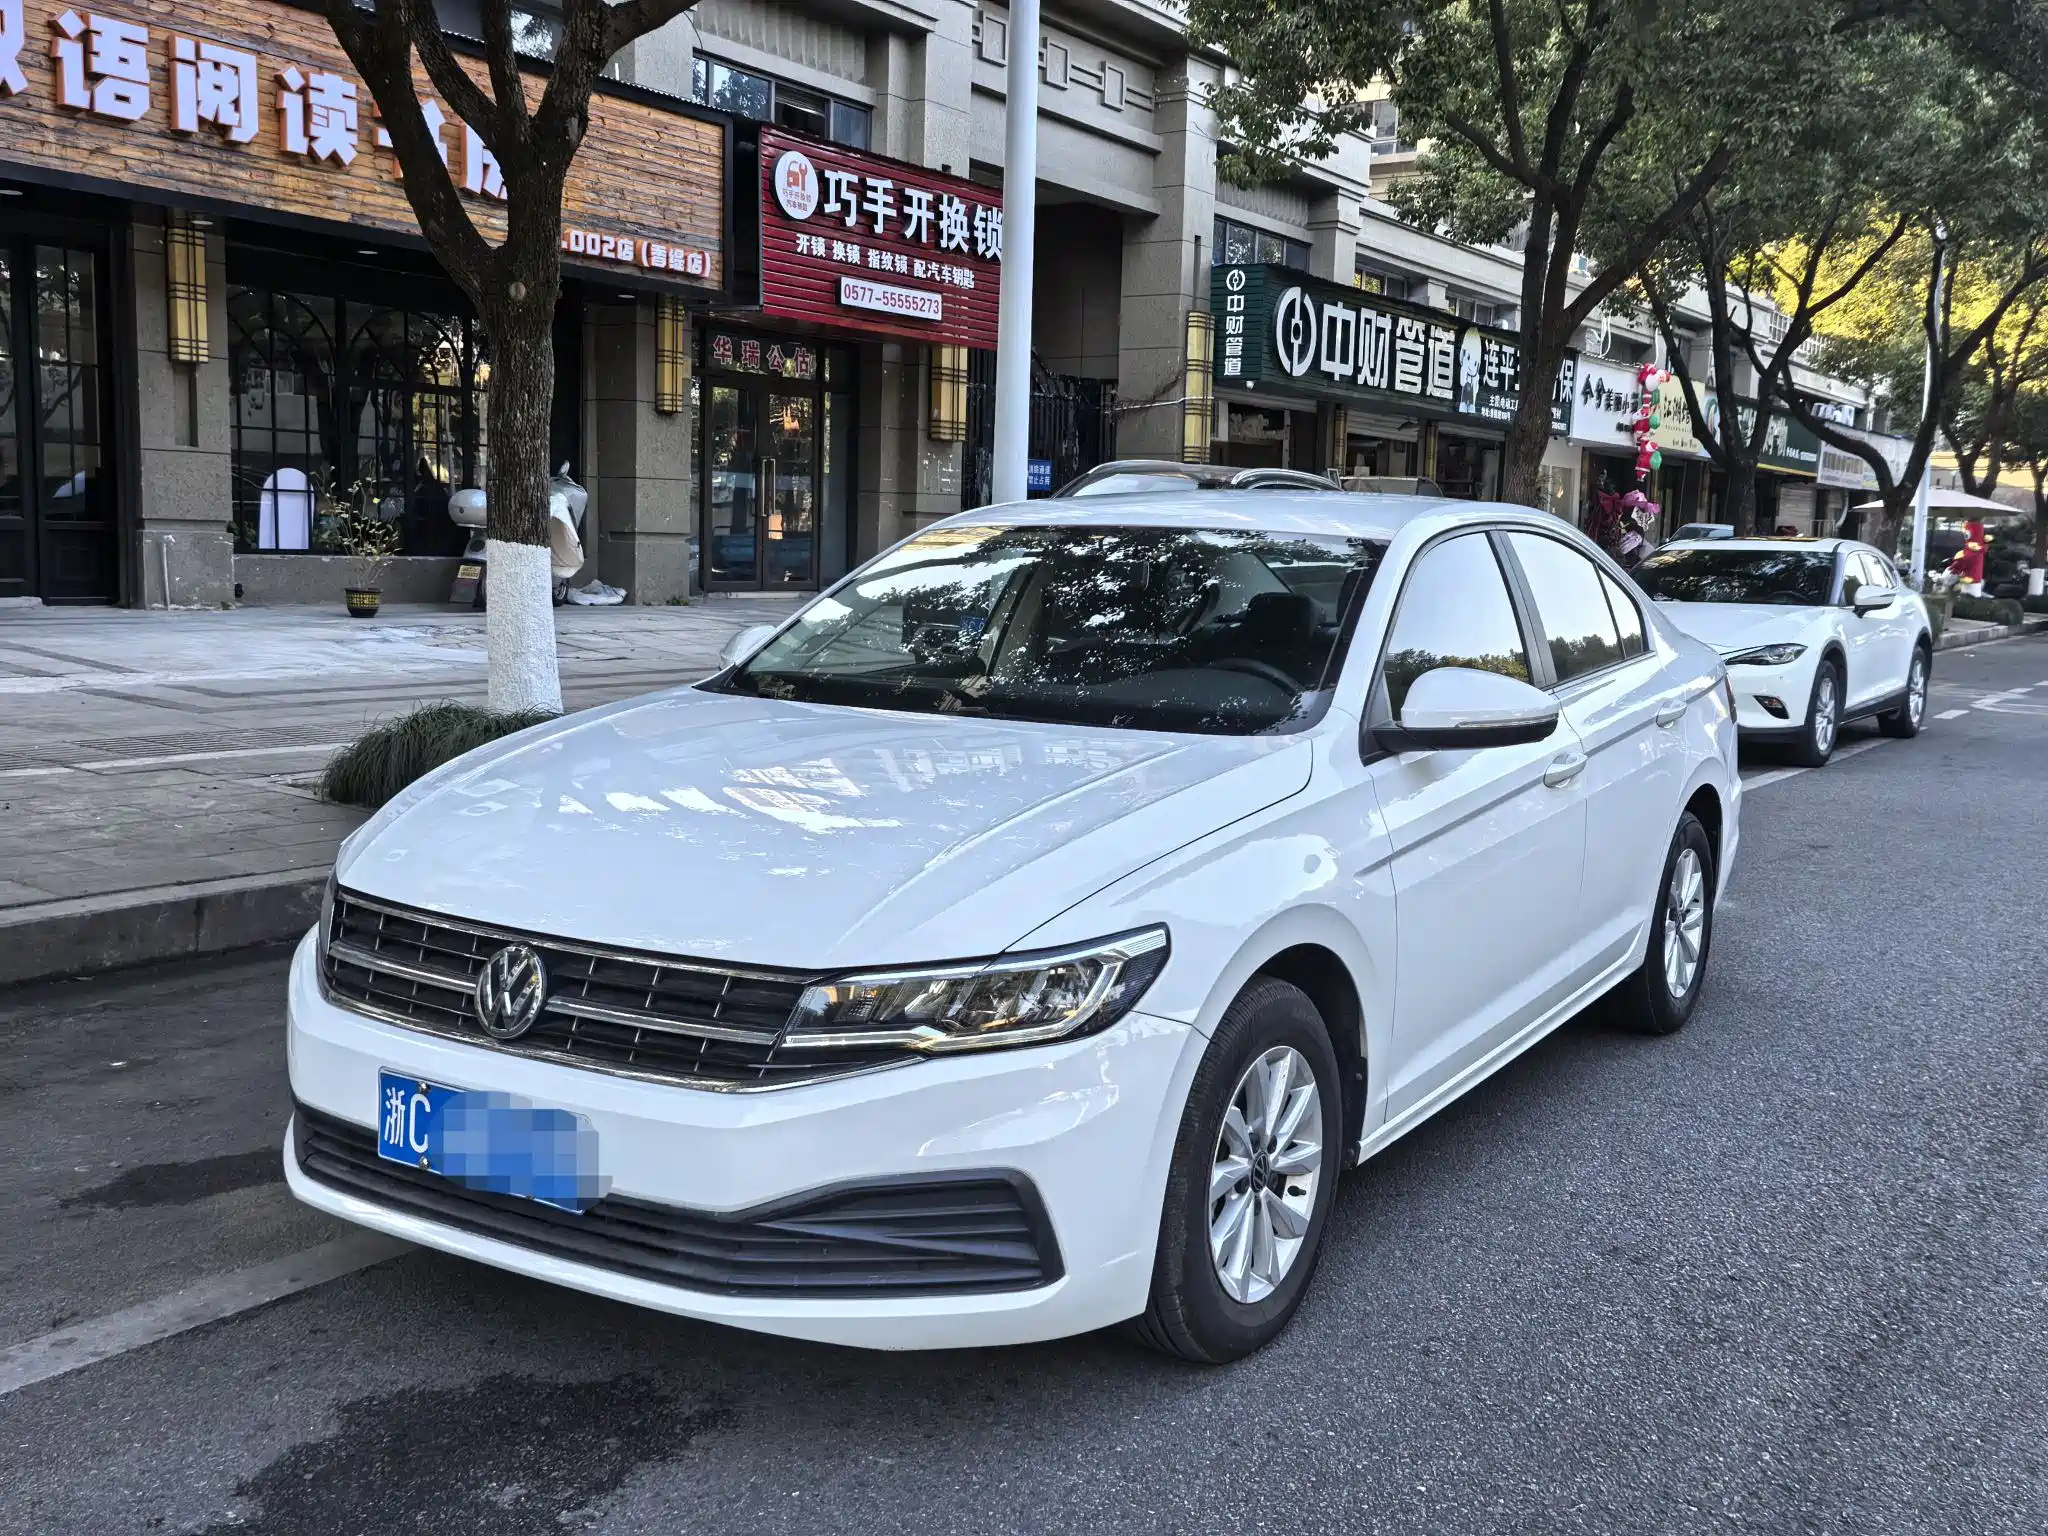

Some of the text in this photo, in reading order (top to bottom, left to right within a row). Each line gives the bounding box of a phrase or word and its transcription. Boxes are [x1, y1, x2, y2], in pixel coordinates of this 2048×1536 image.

[823, 169, 1003, 263] 巧手开换锁
[796, 233, 975, 289] 开锁 换锁 指纹锁 配汽车钥匙
[844, 283, 940, 315] 0577-55555273
[713, 335, 810, 376] 华瑞公估
[1224, 295, 1245, 376] 中财管道
[1320, 301, 1455, 400] 中财管道
